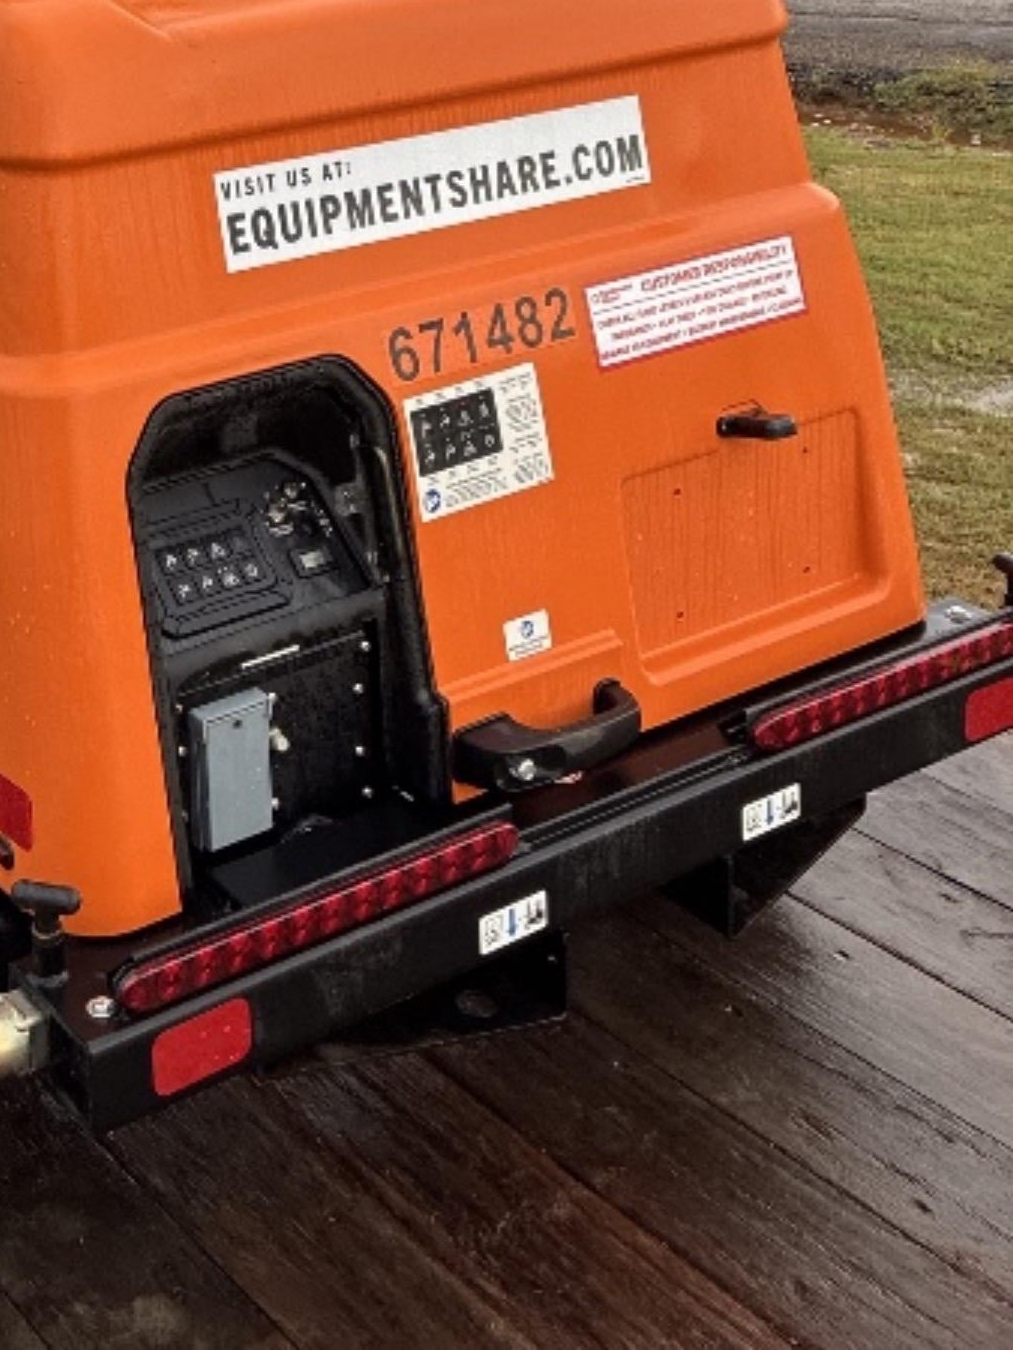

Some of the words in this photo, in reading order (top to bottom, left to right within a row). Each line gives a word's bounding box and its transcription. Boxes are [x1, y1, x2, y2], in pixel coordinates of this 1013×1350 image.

[220, 173, 276, 201] VISIT
[286, 167, 312, 188] US
[322, 161, 351, 181] AT:
[226, 134, 644, 255] EQUIPMENTSHARE.COM
[389, 287, 576, 382] 671482
